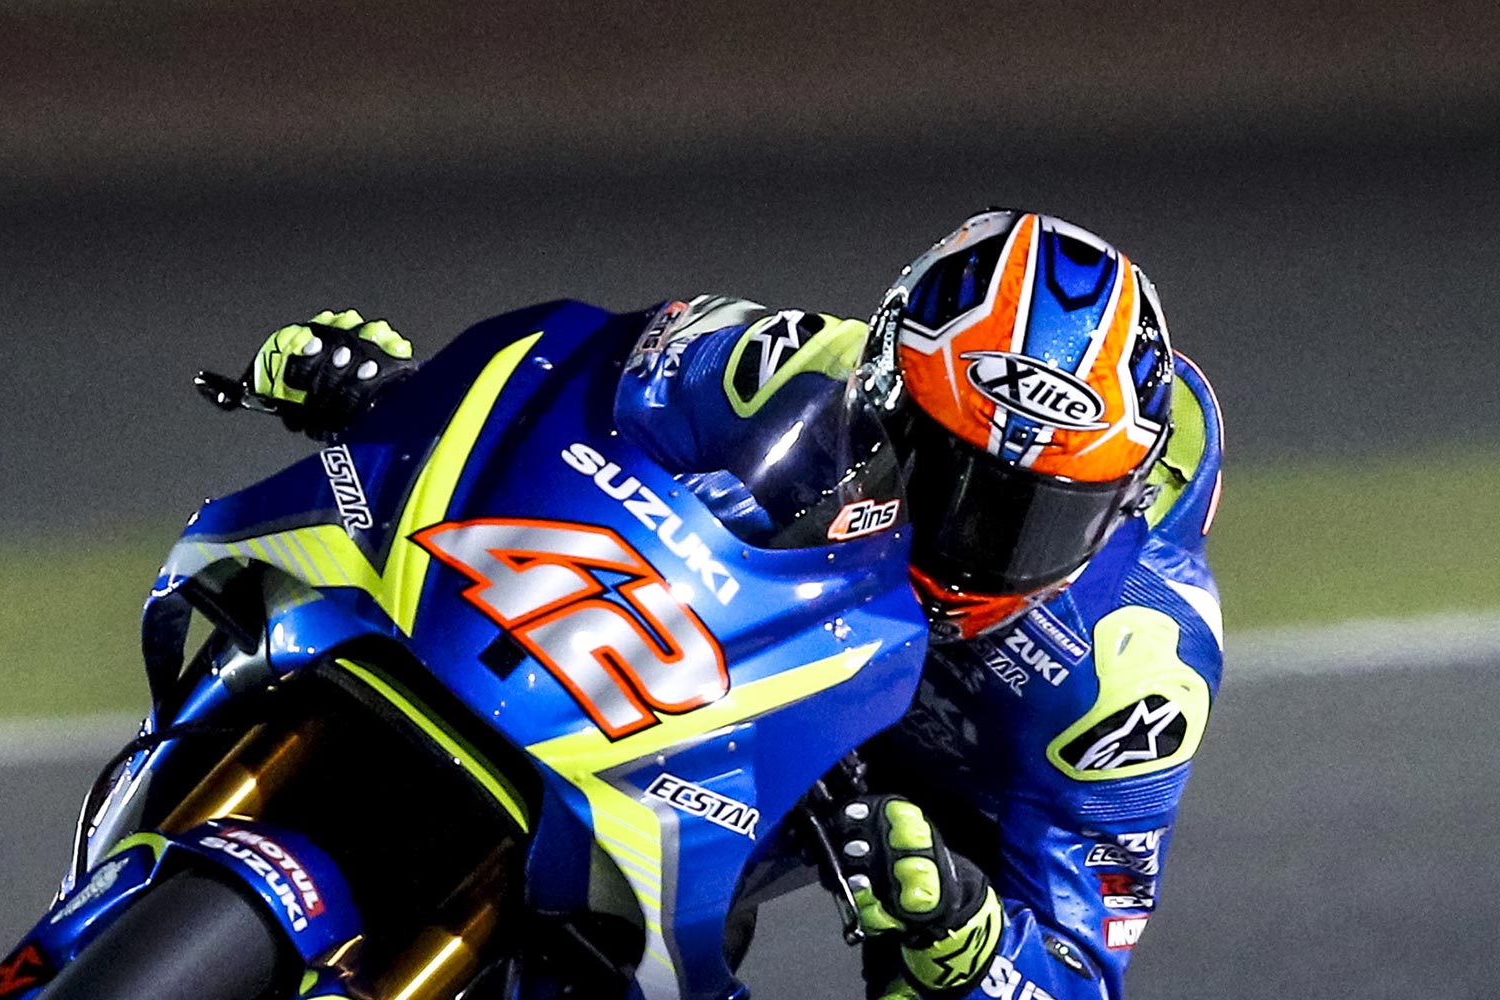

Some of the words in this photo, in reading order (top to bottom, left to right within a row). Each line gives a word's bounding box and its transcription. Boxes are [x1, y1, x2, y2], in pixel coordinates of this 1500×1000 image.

[978, 357, 1088, 420] X-lite
[321, 444, 373, 538] CSTAR
[561, 443, 740, 606] SUZUKI
[407, 517, 731, 743] 42
[1004, 628, 1070, 687] ZUKI
[1028, 608, 1086, 657] MICHELIN
[199, 836, 308, 932] SUZUKI
[226, 830, 320, 911] MOTUL
